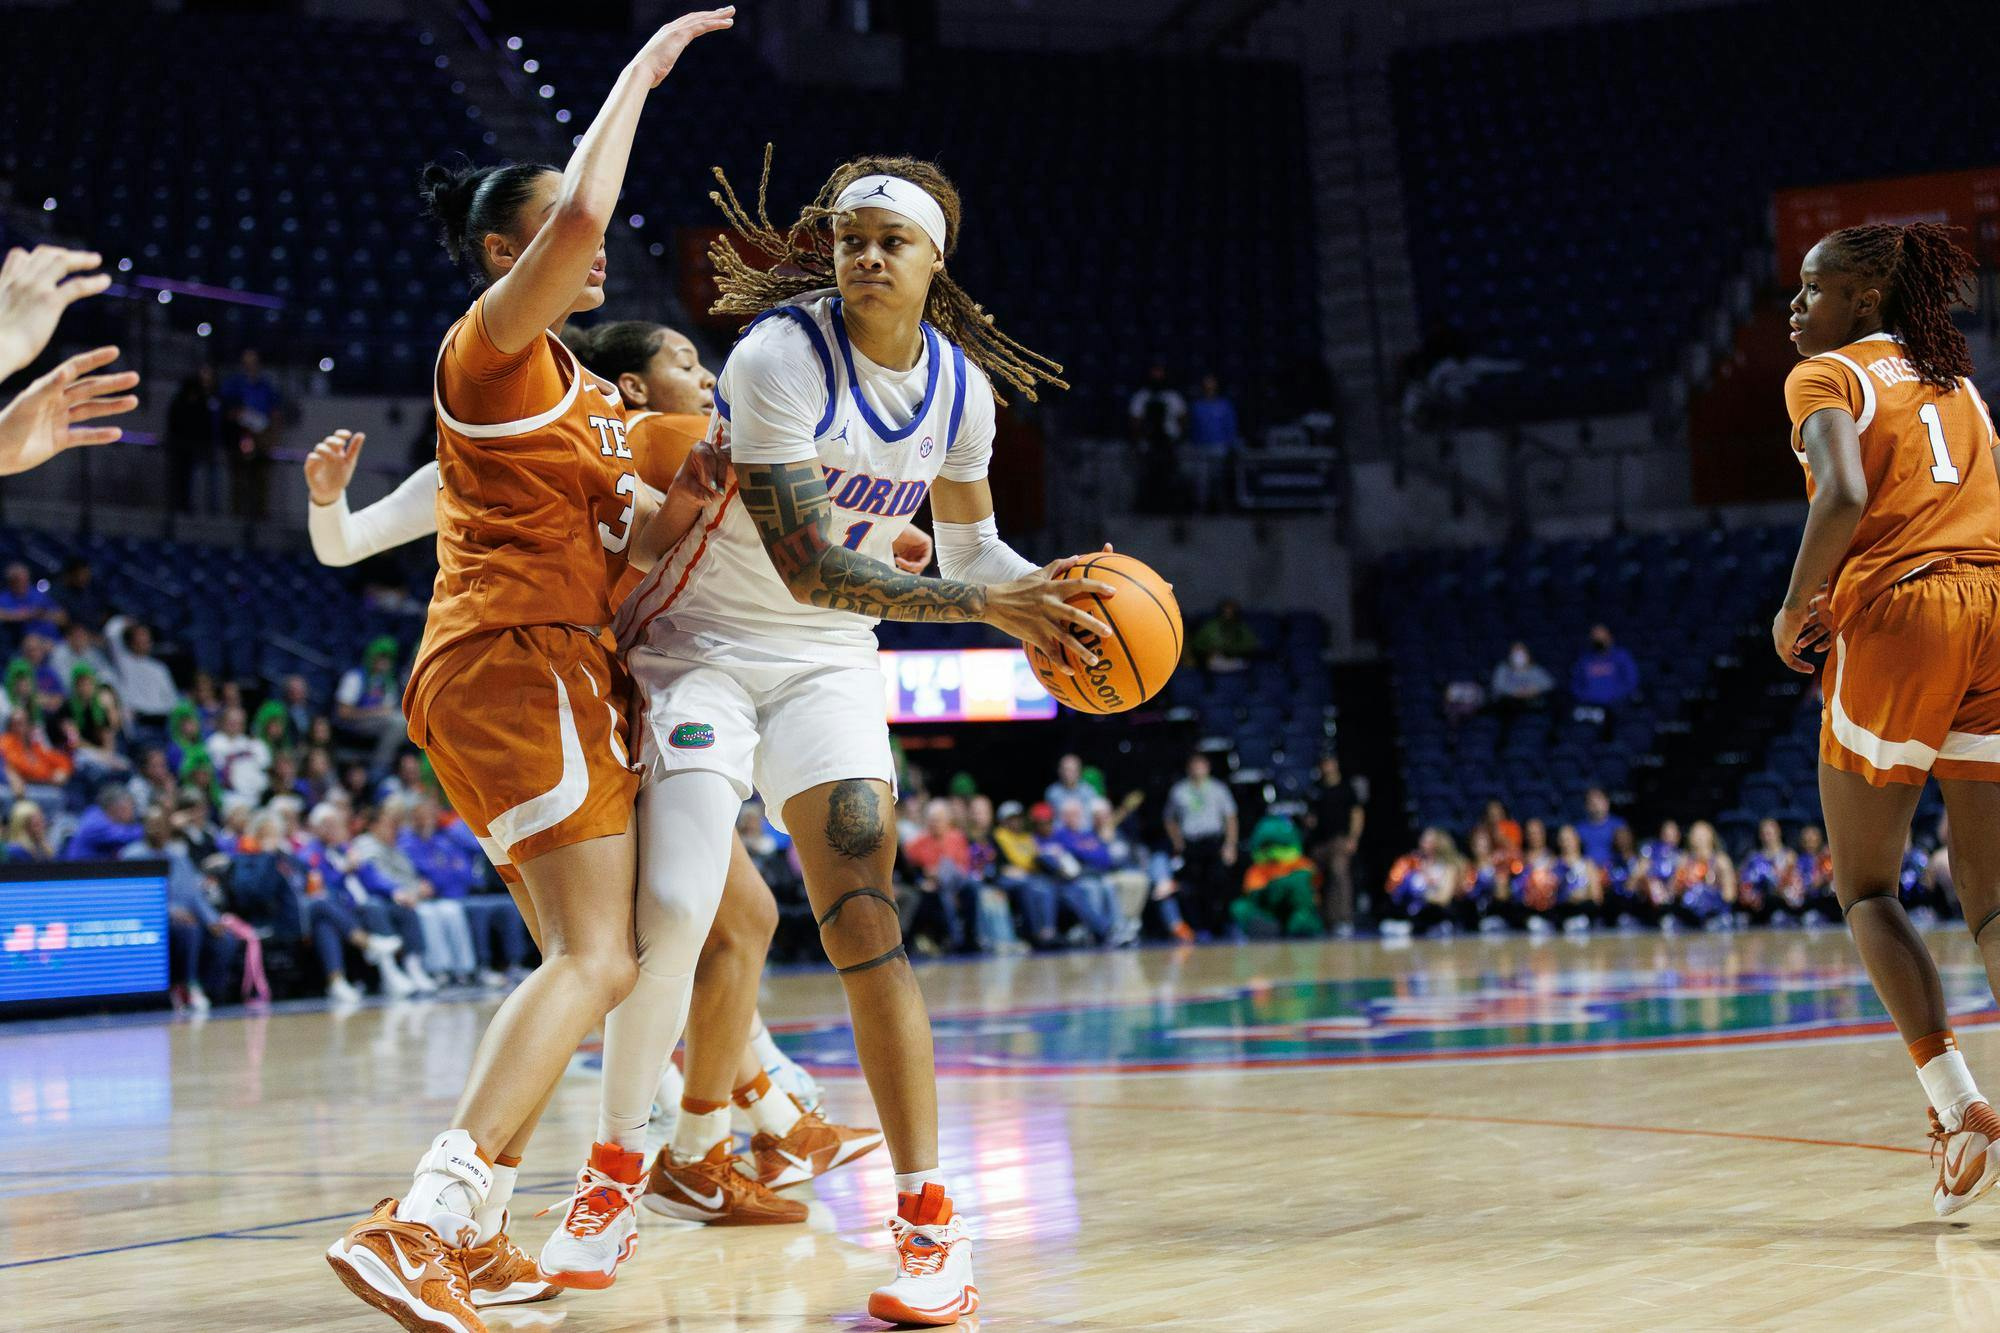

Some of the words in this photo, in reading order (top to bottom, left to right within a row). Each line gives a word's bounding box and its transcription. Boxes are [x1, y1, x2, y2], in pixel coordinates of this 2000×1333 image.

[1918, 402, 1960, 485] 1
[598, 472, 636, 554] 3
[821, 464, 929, 517] LORID
